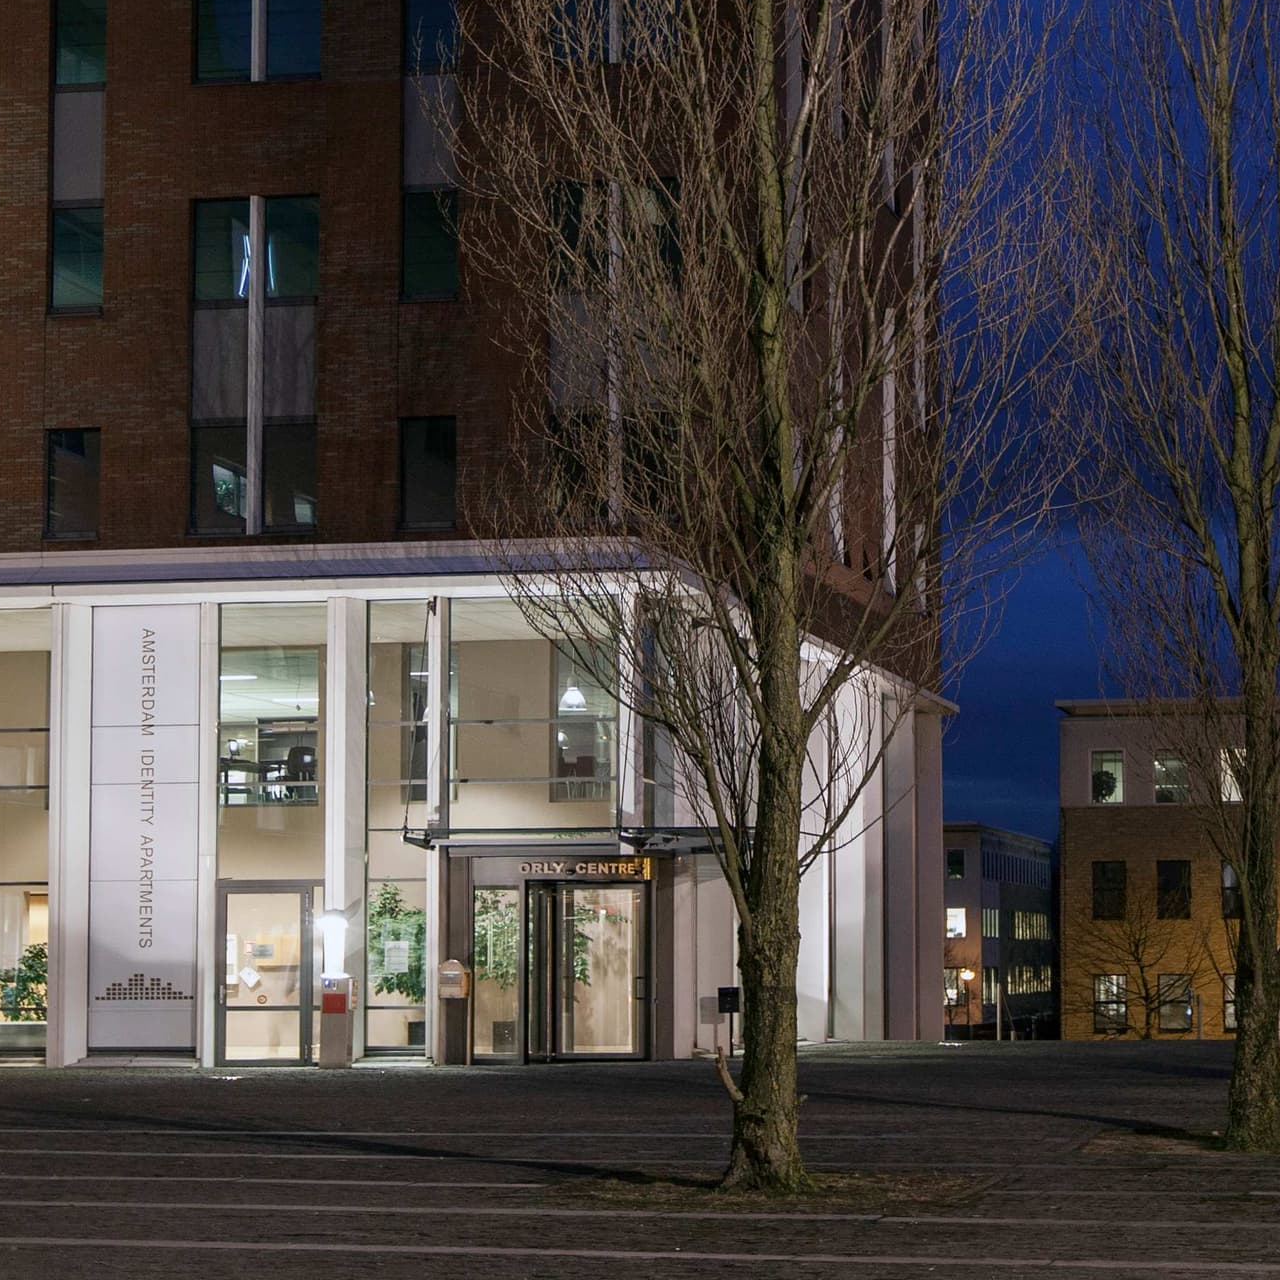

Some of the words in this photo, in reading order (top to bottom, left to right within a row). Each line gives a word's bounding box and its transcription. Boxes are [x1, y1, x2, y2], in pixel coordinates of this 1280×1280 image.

[141, 628, 156, 737] AMSTERDAM
[140, 749, 154, 827] IDENTITY
[139, 835, 154, 949] APARTMENTS
[519, 862, 564, 875] ORLY
[576, 863, 635, 874] CENTRE
